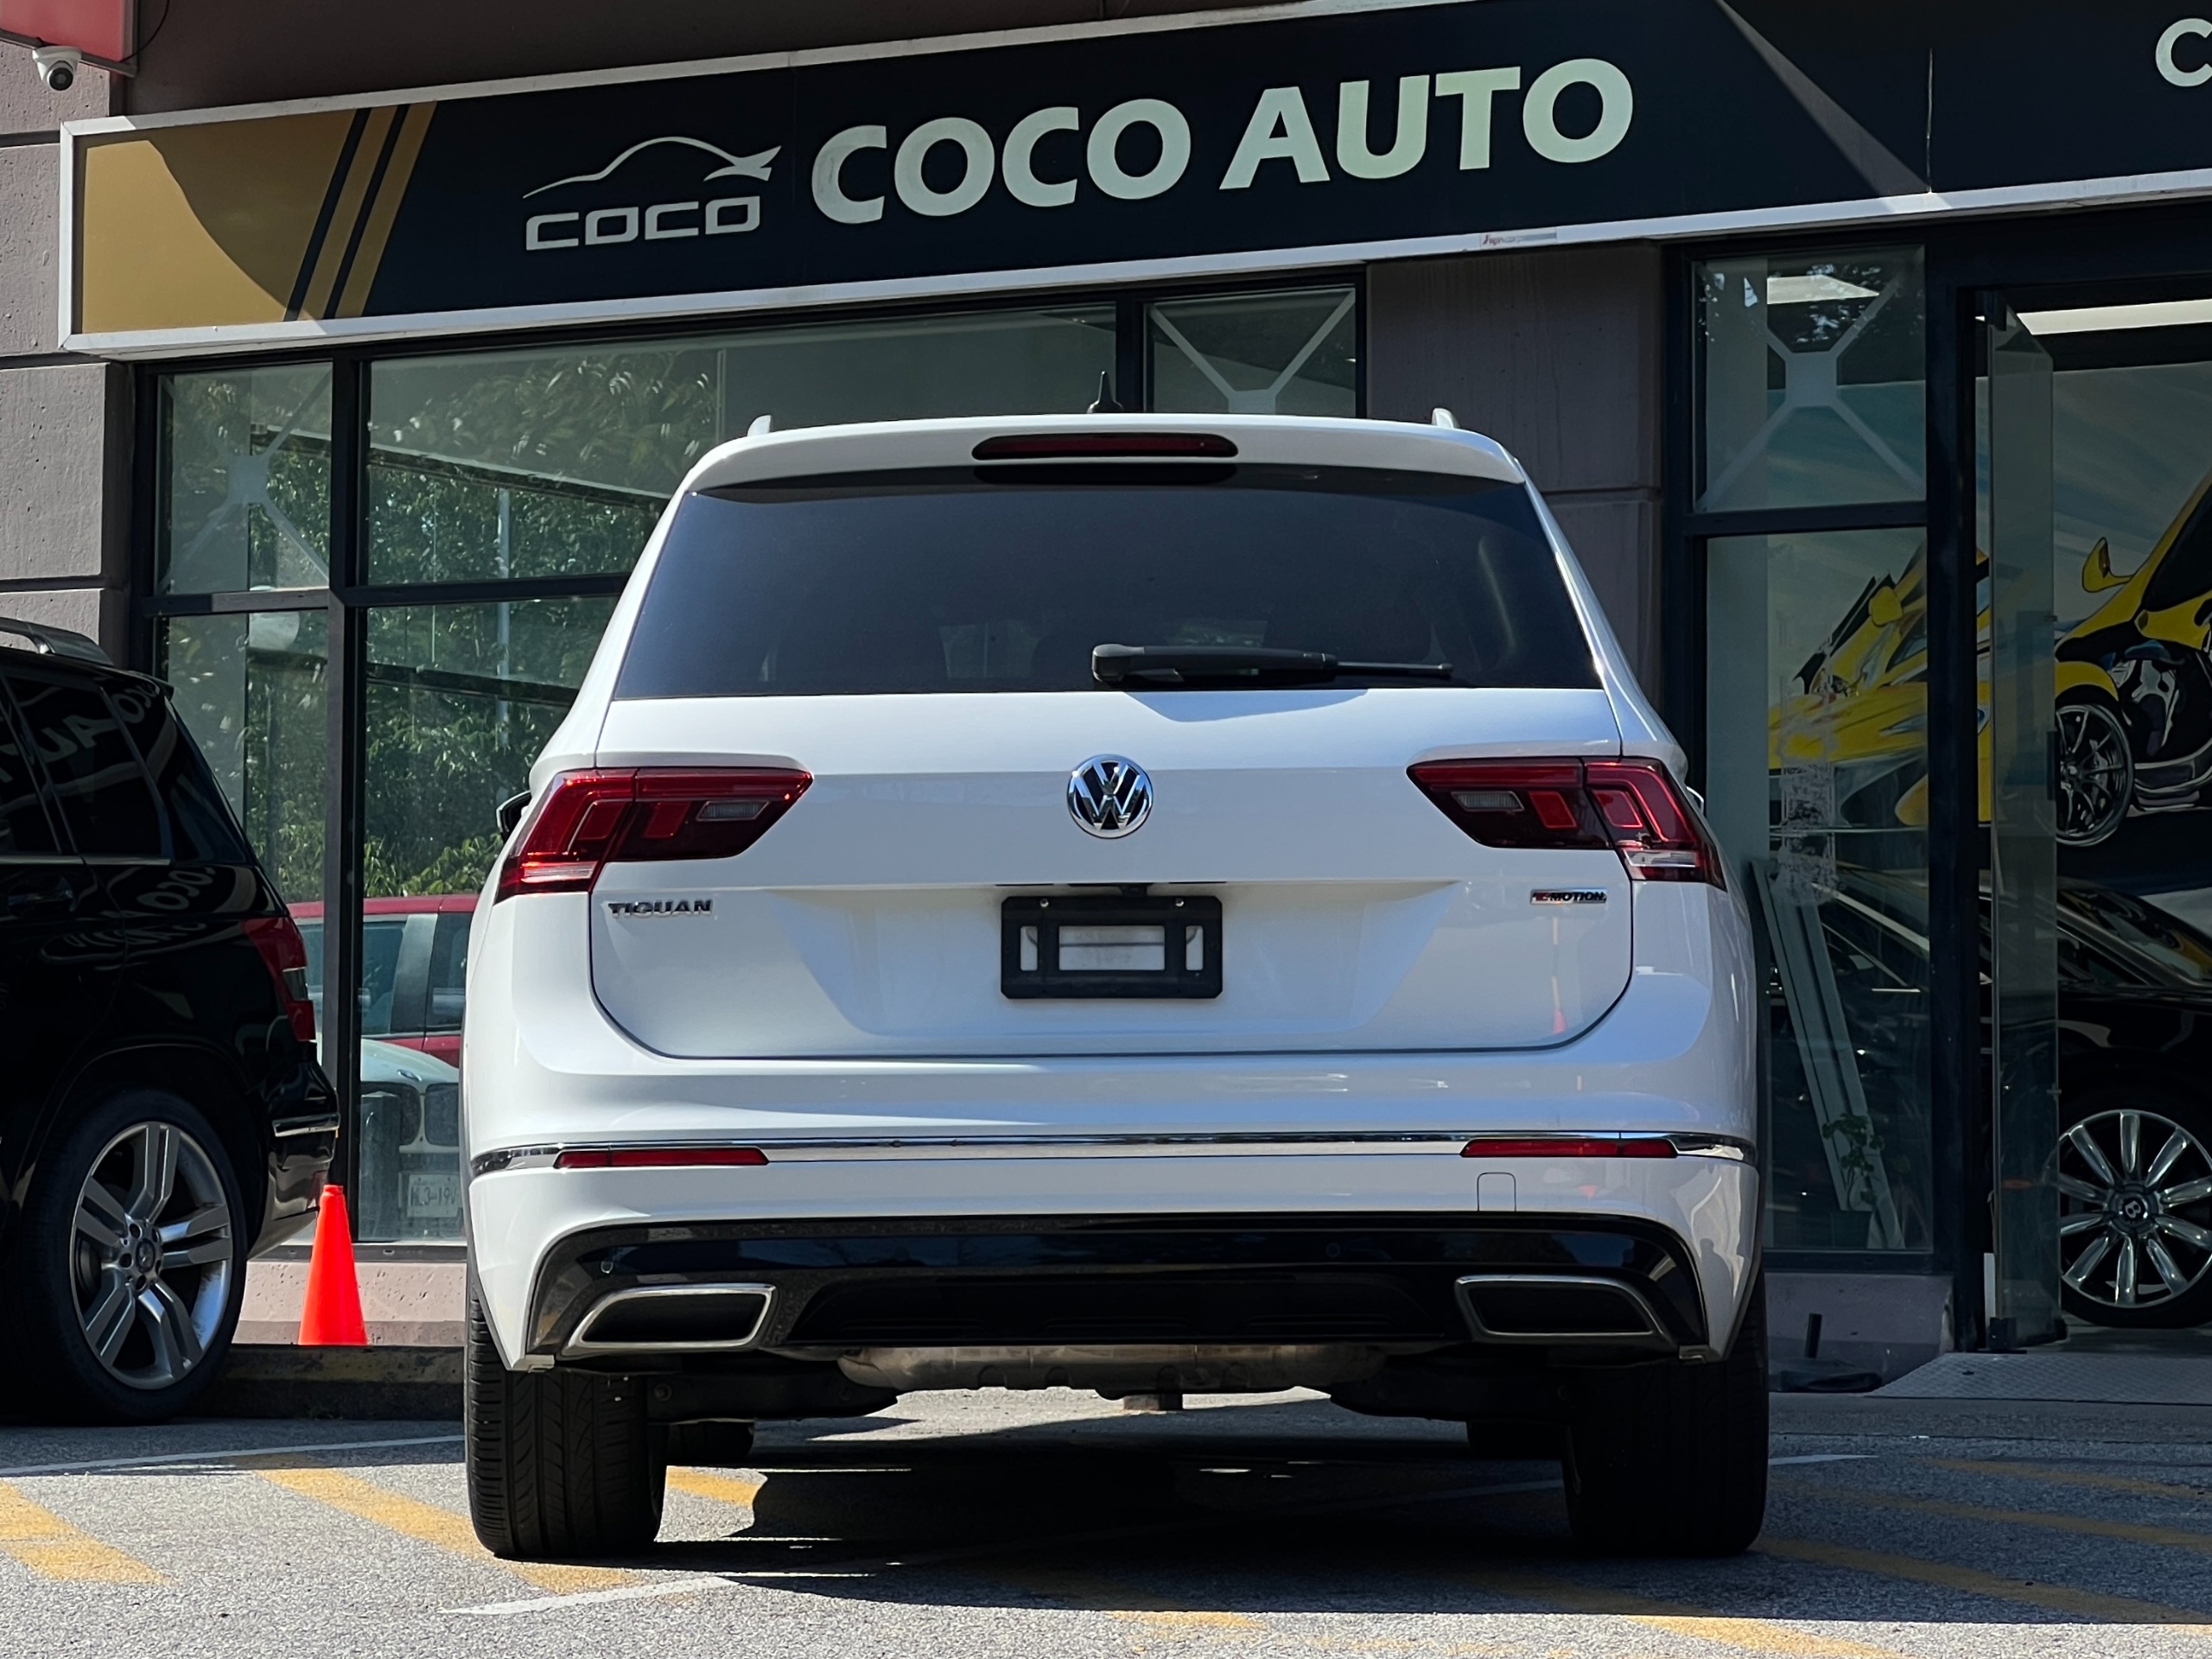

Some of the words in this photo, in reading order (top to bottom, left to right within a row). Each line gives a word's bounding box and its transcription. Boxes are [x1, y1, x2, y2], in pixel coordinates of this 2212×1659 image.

[810, 98, 1192, 225] COCO
[1218, 58, 1634, 190] AUTO
[525, 195, 760, 251] COCO
[607, 899, 712, 918] TIGUAN
